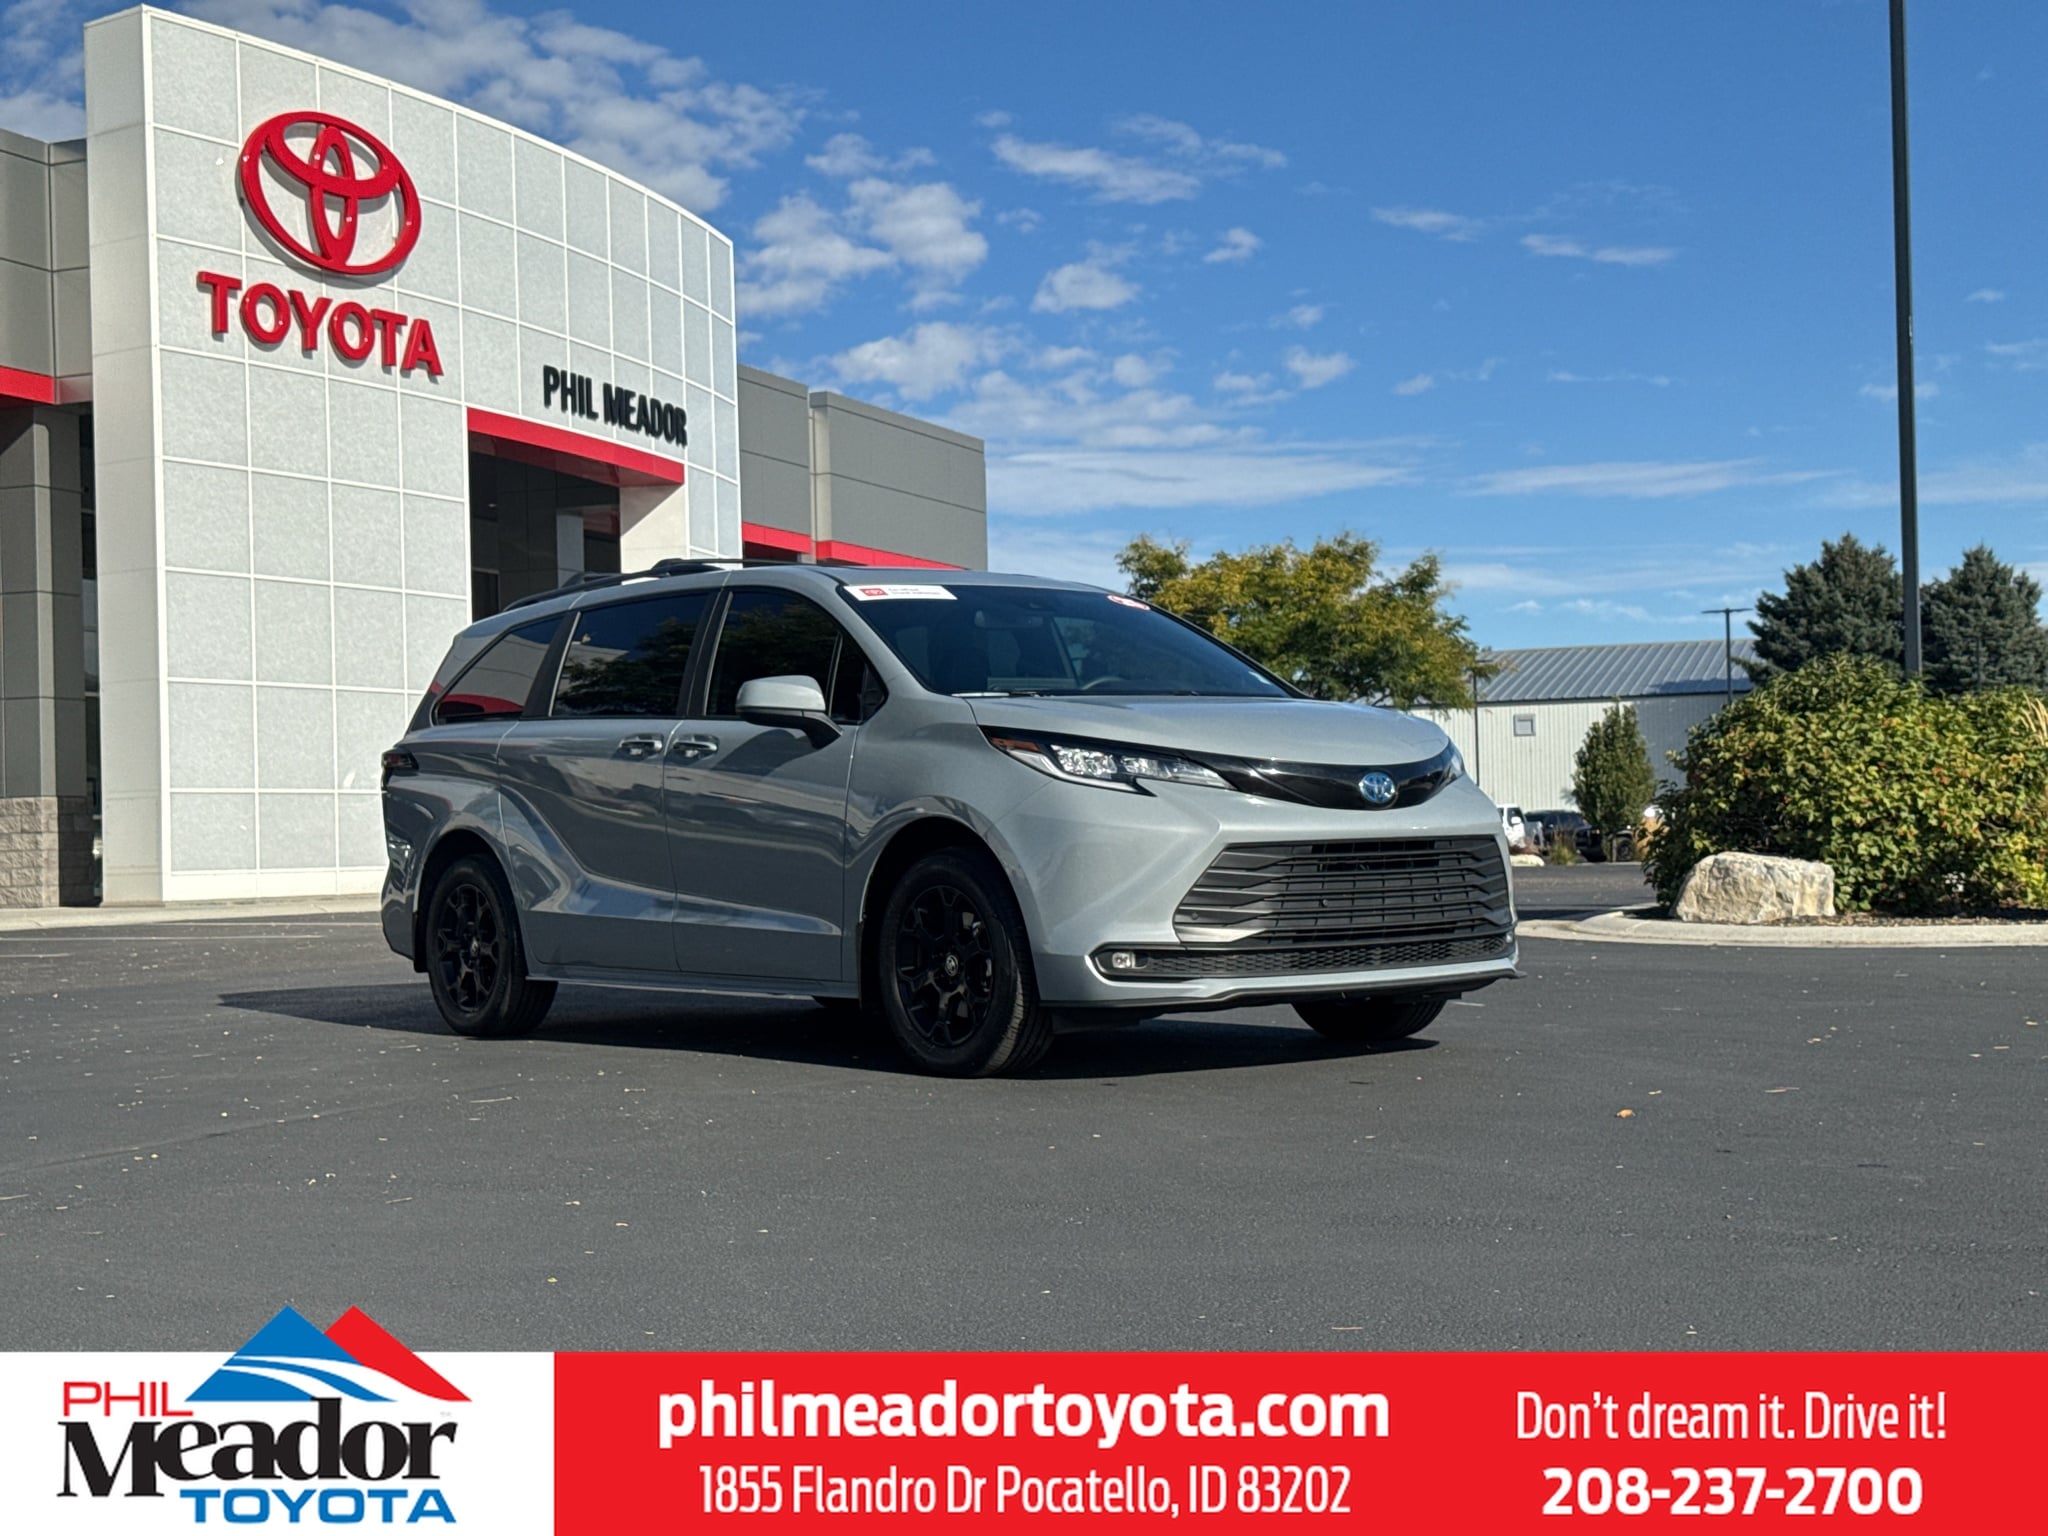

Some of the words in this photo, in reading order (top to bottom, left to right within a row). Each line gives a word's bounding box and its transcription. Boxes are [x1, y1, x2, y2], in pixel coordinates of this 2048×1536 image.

[197, 271, 444, 376] TOYOTA
[543, 365, 599, 421] PHIL
[603, 382, 688, 448] MEADOR
